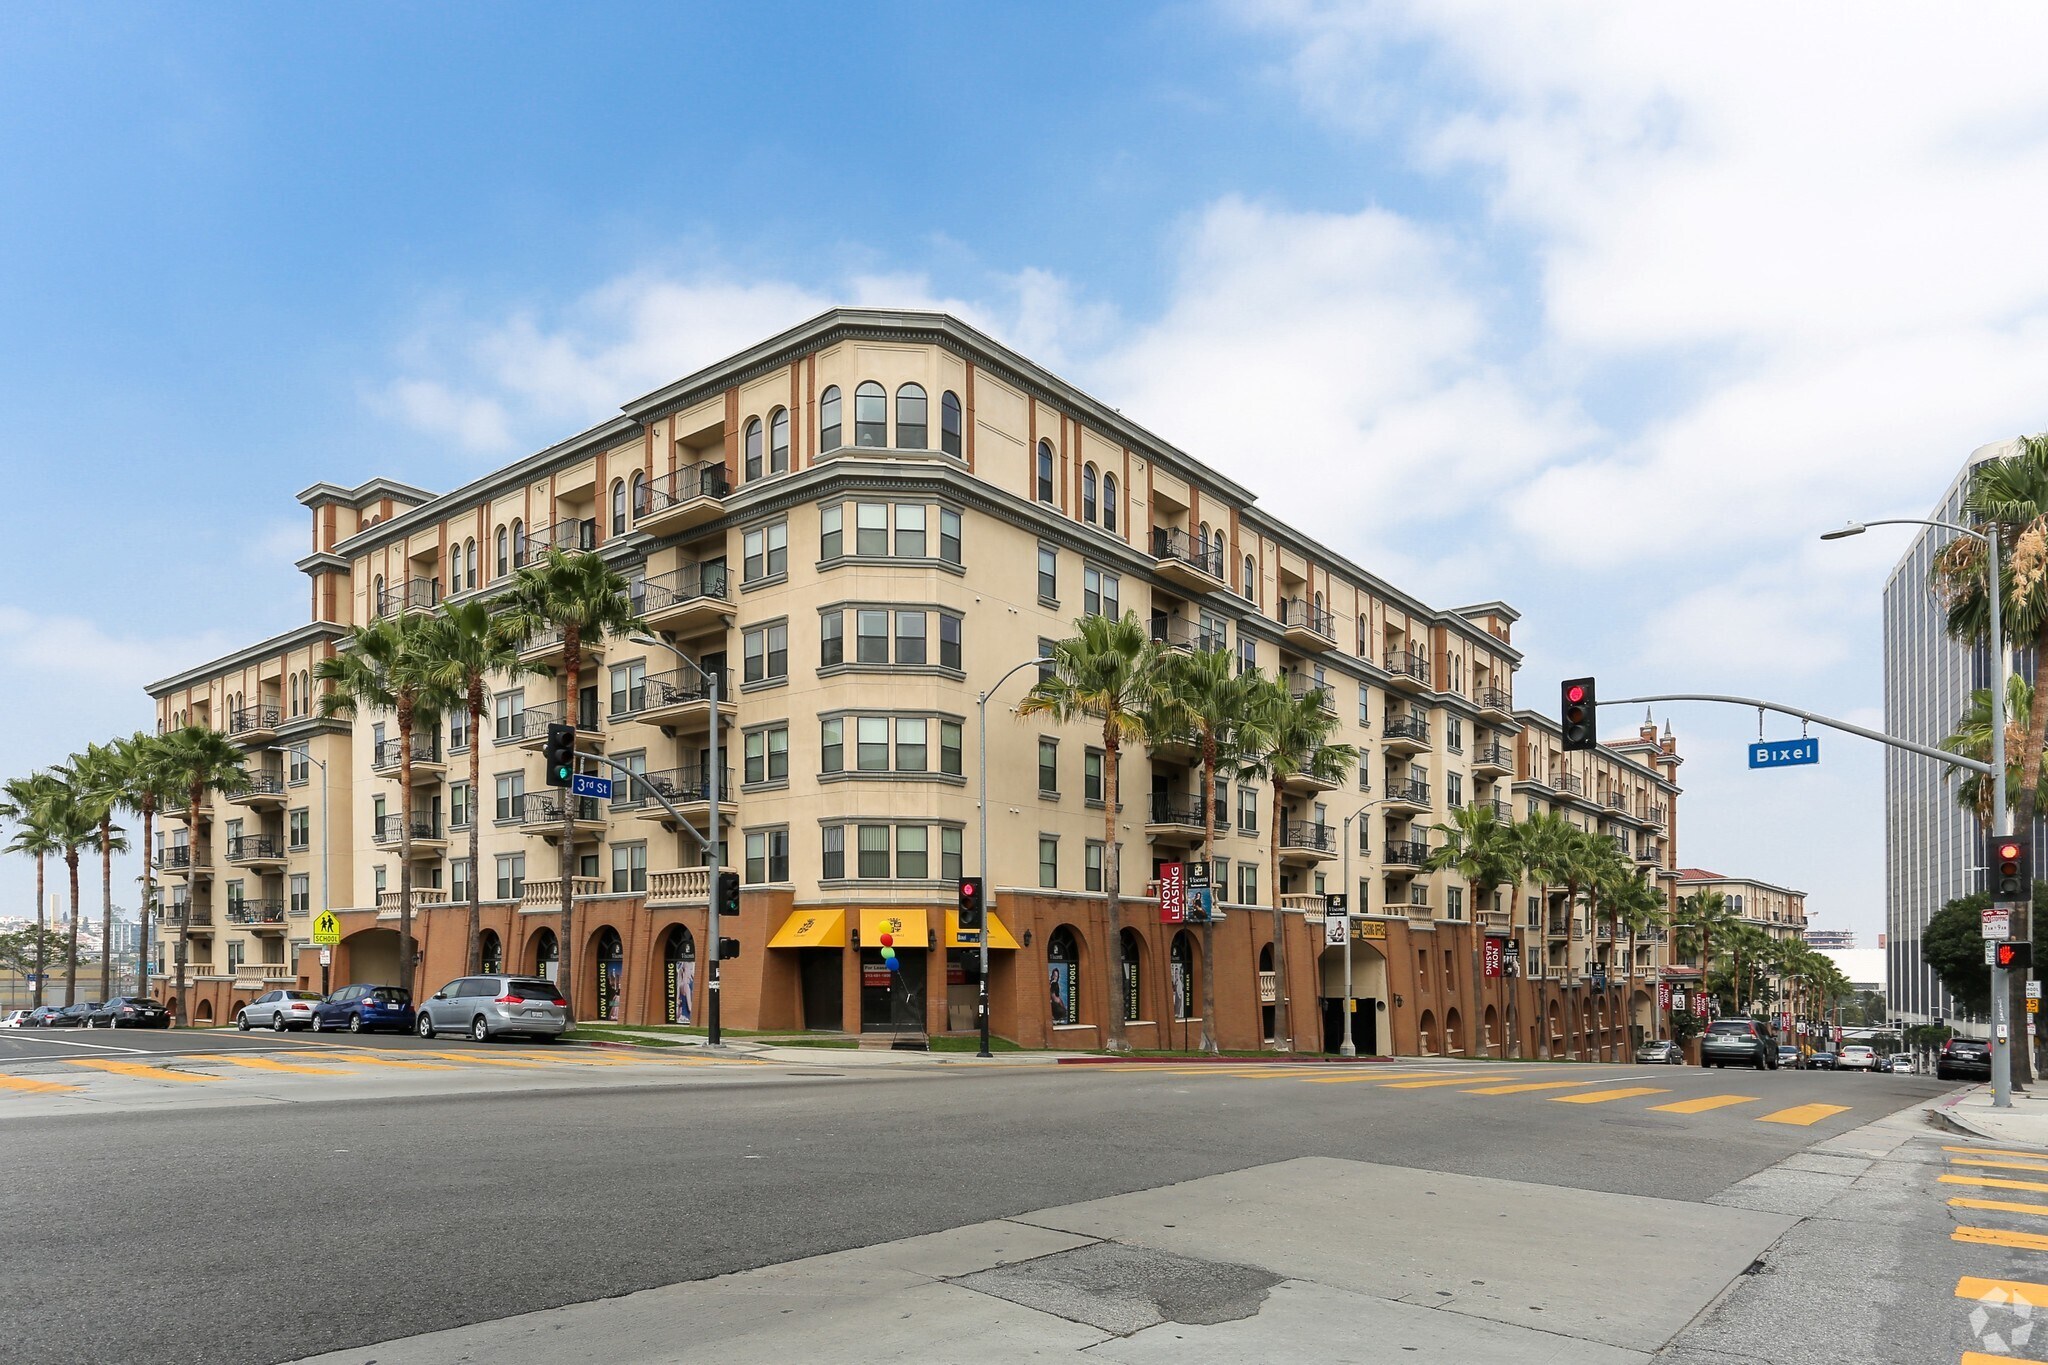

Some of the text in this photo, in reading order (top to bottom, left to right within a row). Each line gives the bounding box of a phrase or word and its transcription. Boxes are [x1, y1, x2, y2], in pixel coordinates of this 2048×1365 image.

[1756, 745, 1811, 762] Bixel
[577, 779, 607, 794] 3rd St
[1162, 878, 1170, 909] NOW
[1171, 866, 1180, 920] LEASING
